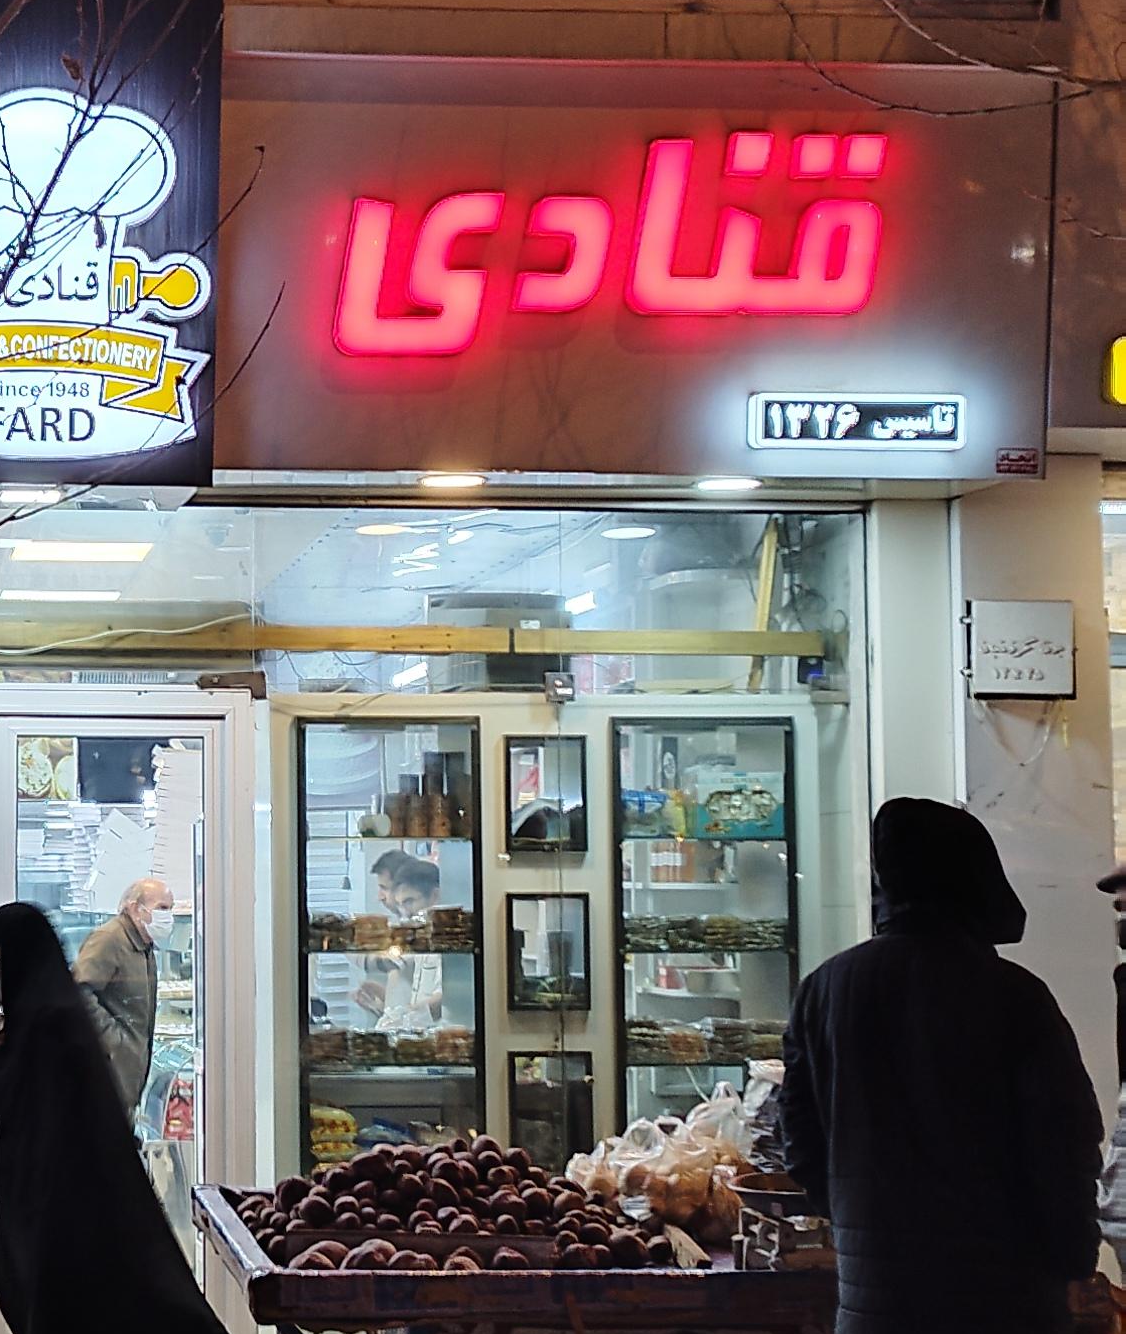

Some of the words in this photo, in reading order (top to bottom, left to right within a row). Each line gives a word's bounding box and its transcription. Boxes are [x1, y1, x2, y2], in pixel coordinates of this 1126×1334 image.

[333, 131, 889, 357] قنادی
[4, 261, 100, 308] قنادی
[10, 332, 159, 372] CONFECTIONERY
[48, 381, 90, 398] 1948
